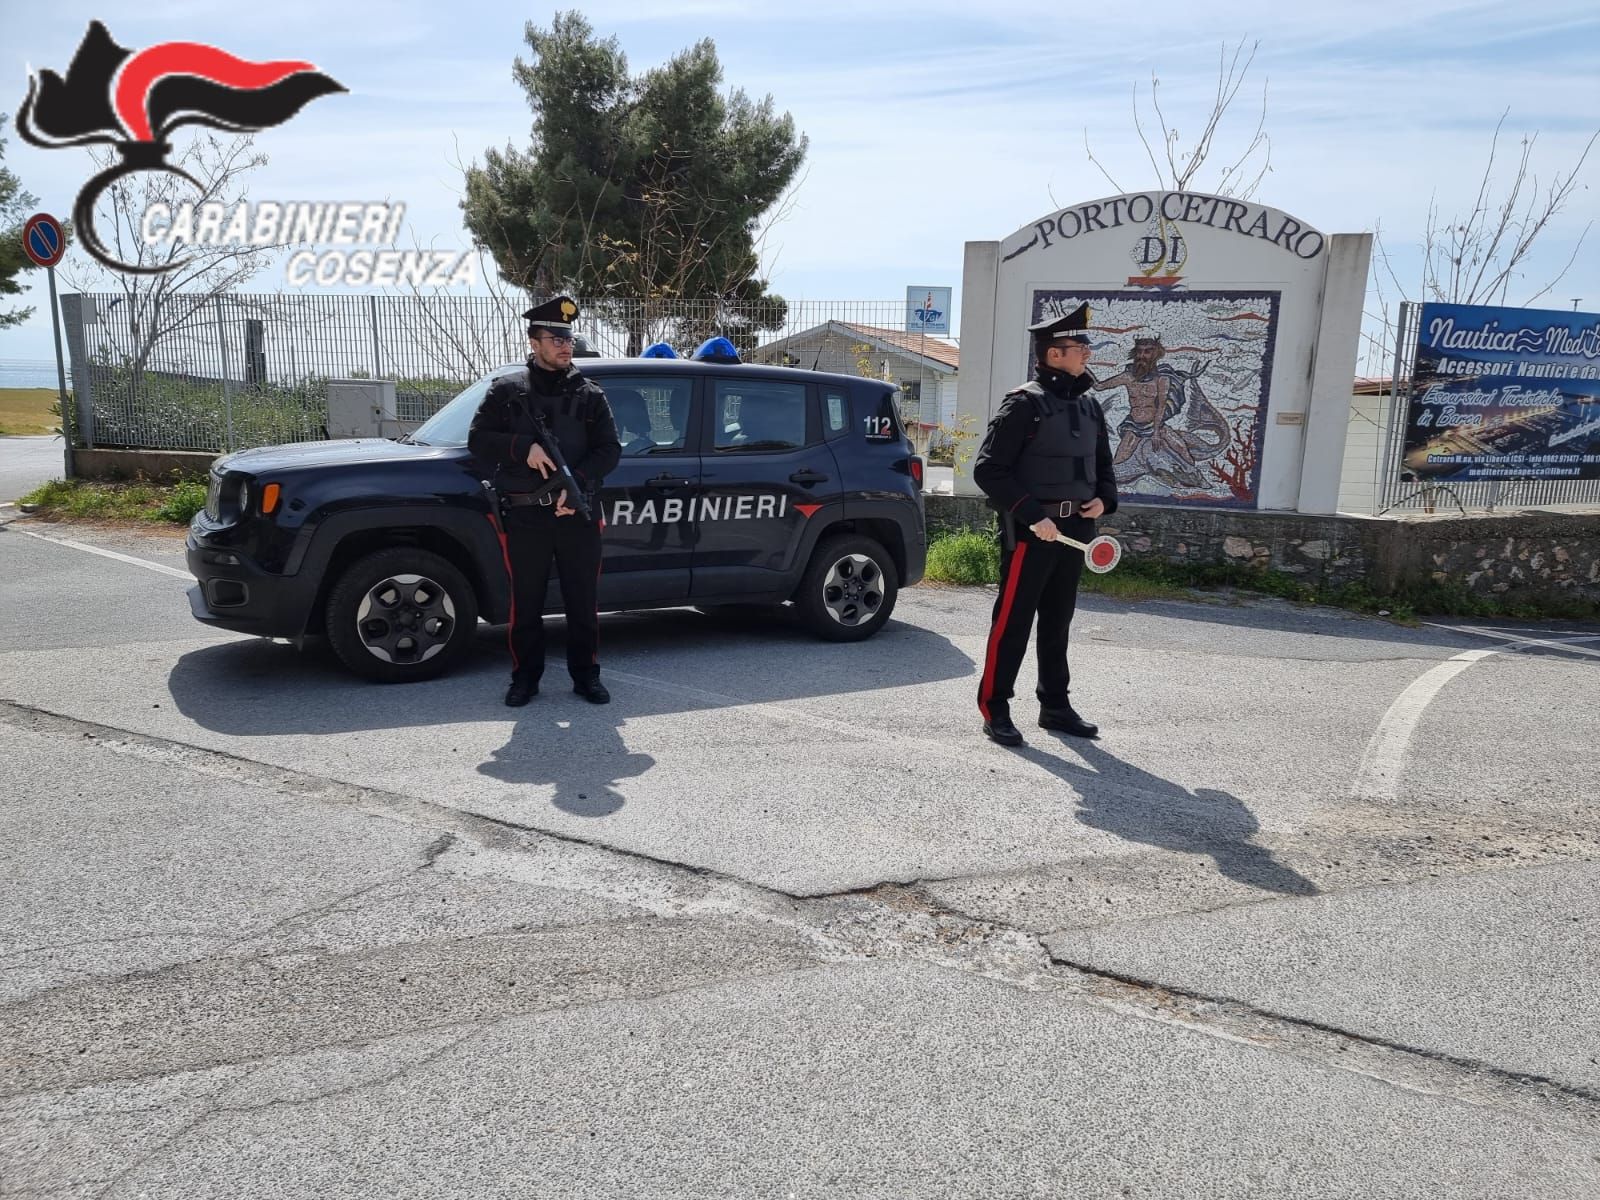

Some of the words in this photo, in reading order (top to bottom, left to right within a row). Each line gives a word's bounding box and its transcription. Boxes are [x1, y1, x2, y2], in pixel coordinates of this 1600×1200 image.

[1036, 195, 1153, 249] PORTO
[1160, 193, 1324, 260] CETRARO
[1140, 236, 1183, 264] DI
[1430, 318, 1517, 351] Nautica
[1437, 357, 1513, 376] Accessori
[1517, 361, 1569, 378] Nautici
[1570, 366, 1579, 379] e
[863, 415, 891, 435] 112
[1436, 406, 1483, 428] Barca
